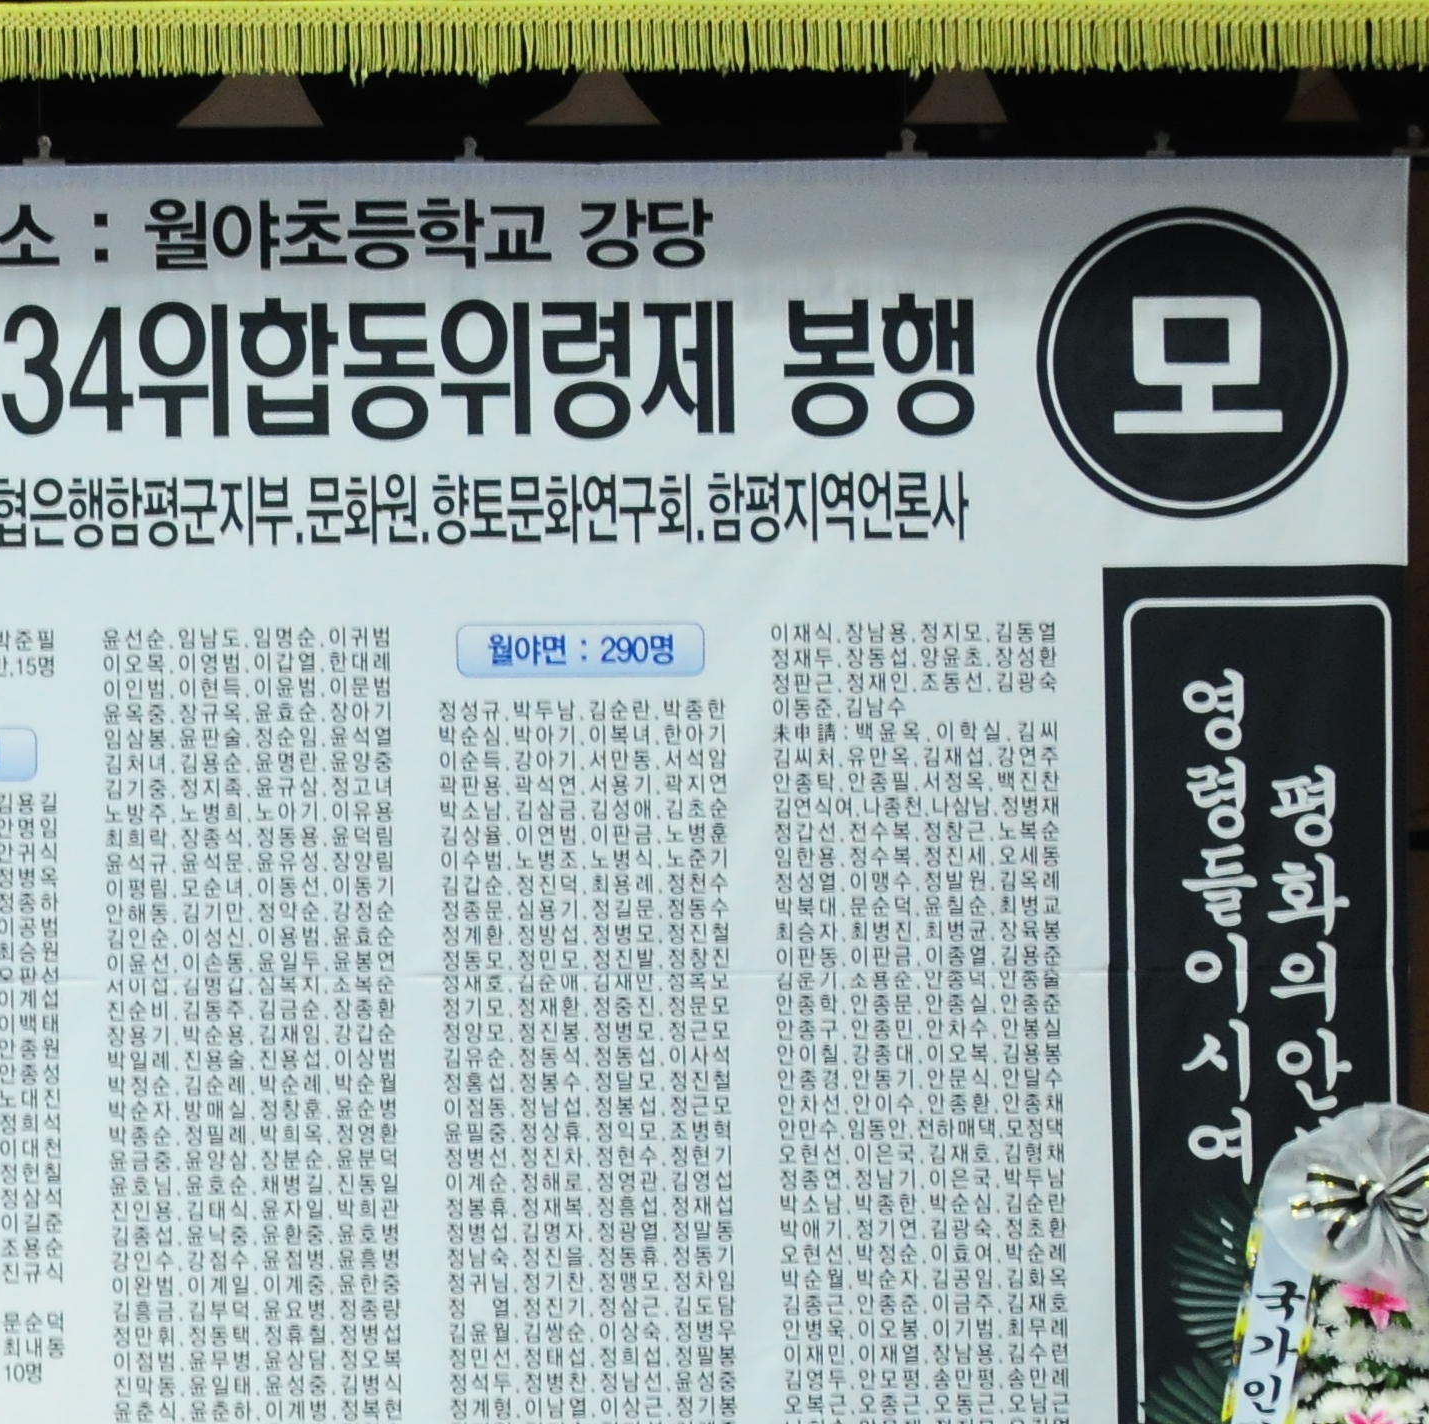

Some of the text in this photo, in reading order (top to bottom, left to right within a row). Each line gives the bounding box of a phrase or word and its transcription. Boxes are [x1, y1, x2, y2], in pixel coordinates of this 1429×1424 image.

[144, 197, 552, 271] 월야초등학교
[579, 197, 714, 269] 강당
[784, 292, 975, 437] 봉행
[1113, 296, 1283, 434] 모
[488, 634, 566, 666] 월야면
[601, 634, 674, 665] 290명
[1182, 668, 1258, 1185] 영령들이시여
[1268, 765, 1349, 1022] 평화의
